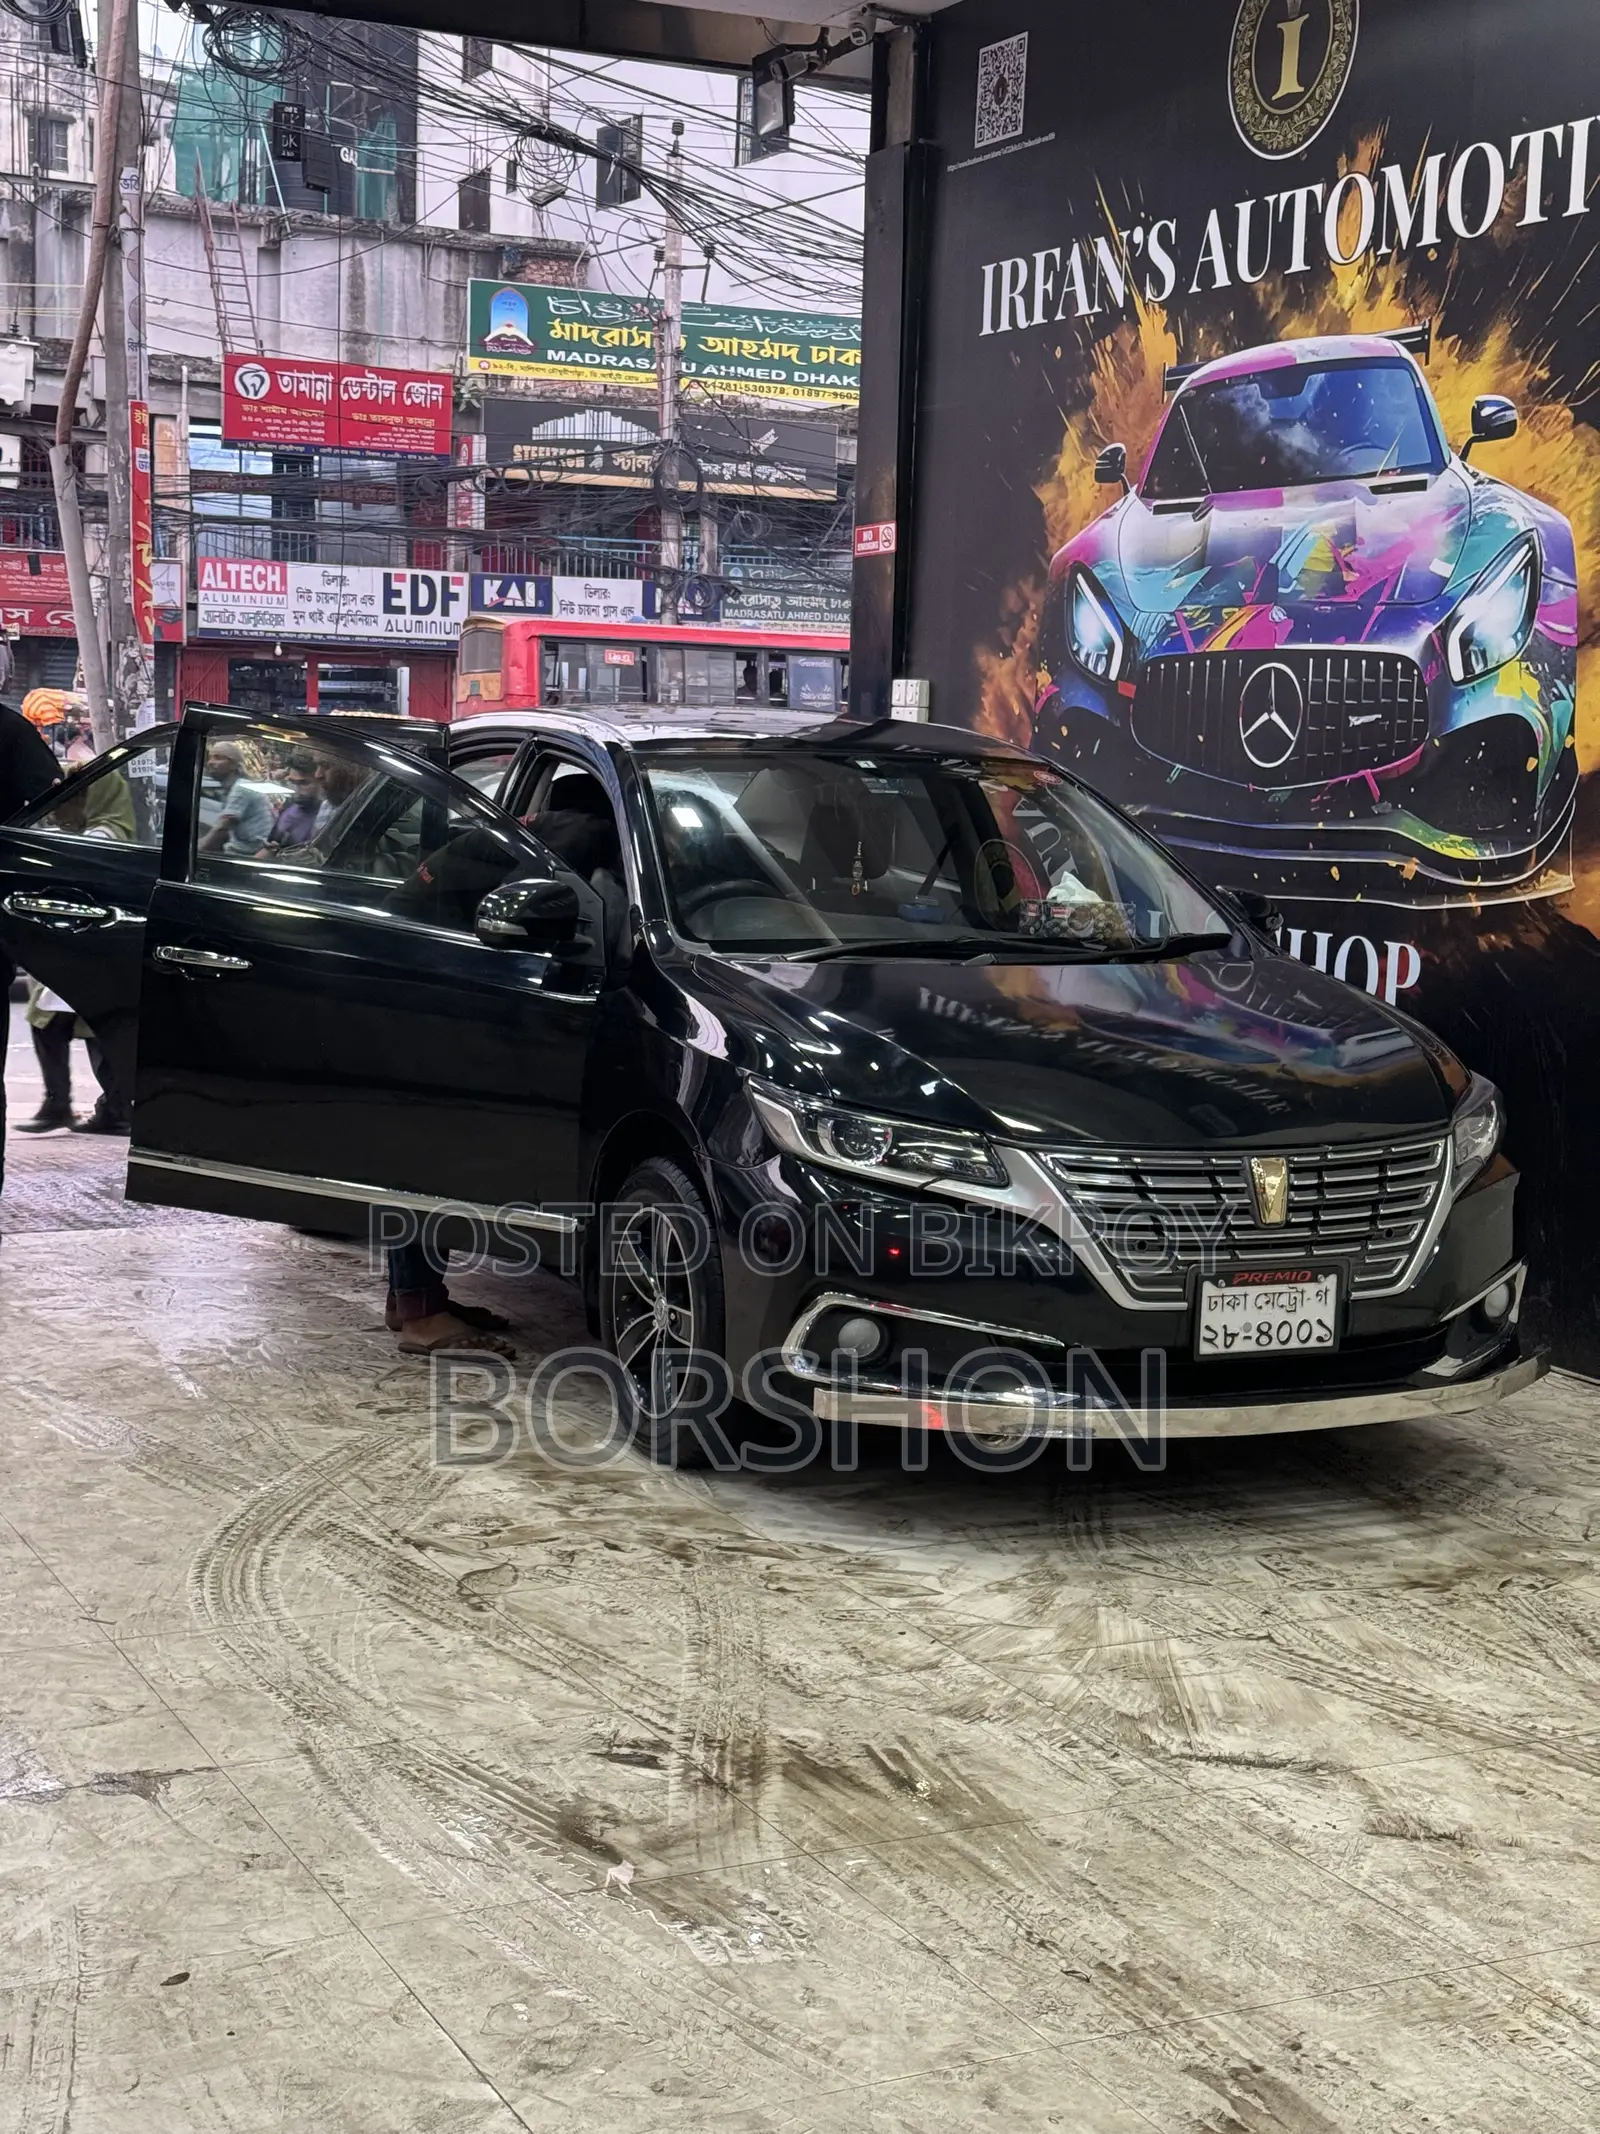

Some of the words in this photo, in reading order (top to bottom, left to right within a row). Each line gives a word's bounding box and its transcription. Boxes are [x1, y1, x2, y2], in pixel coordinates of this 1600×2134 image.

[979, 218, 1177, 336] IRFAN'S
[1188, 115, 1600, 294] AUTOMOTI
[698, 336, 807, 365] আহমদ
[809, 345, 861, 367] ঢাক
[547, 350, 696, 374] MADRASAU
[702, 364, 787, 381] AHMED
[793, 371, 861, 387] DHAK
[275, 369, 334, 405] তামান্না
[341, 369, 398, 406] ডেন্টাল
[403, 380, 445, 410] জোন
[793, 387, 861, 400] 01897-9602
[201, 562, 280, 592] ALTECH
[202, 592, 285, 605] ALUMINIUM
[296, 587, 313, 603] নিউ
[315, 591, 340, 605] চায়না
[341, 594, 358, 607] গ্লাস
[383, 572, 464, 617] EDF
[483, 579, 536, 608] KAI
[308, 608, 324, 624] থাই
[559, 599, 575, 615] নিউ
[578, 604, 601, 616] চায়না
[603, 605, 618, 618] গ্লাস
[725, 608, 785, 620] MADRASATU
[786, 610, 821, 621] AHMED
[384, 618, 461, 635] ALUMINIUM
[1277, 926, 1421, 1007] HOP
[1232, 1270, 1312, 1285] PREMIO
[1207, 1291, 1249, 1312] ঢাকা
[1315, 1286, 1330, 1306] গ
[1203, 1318, 1333, 1349] ২৮-৪০০১
